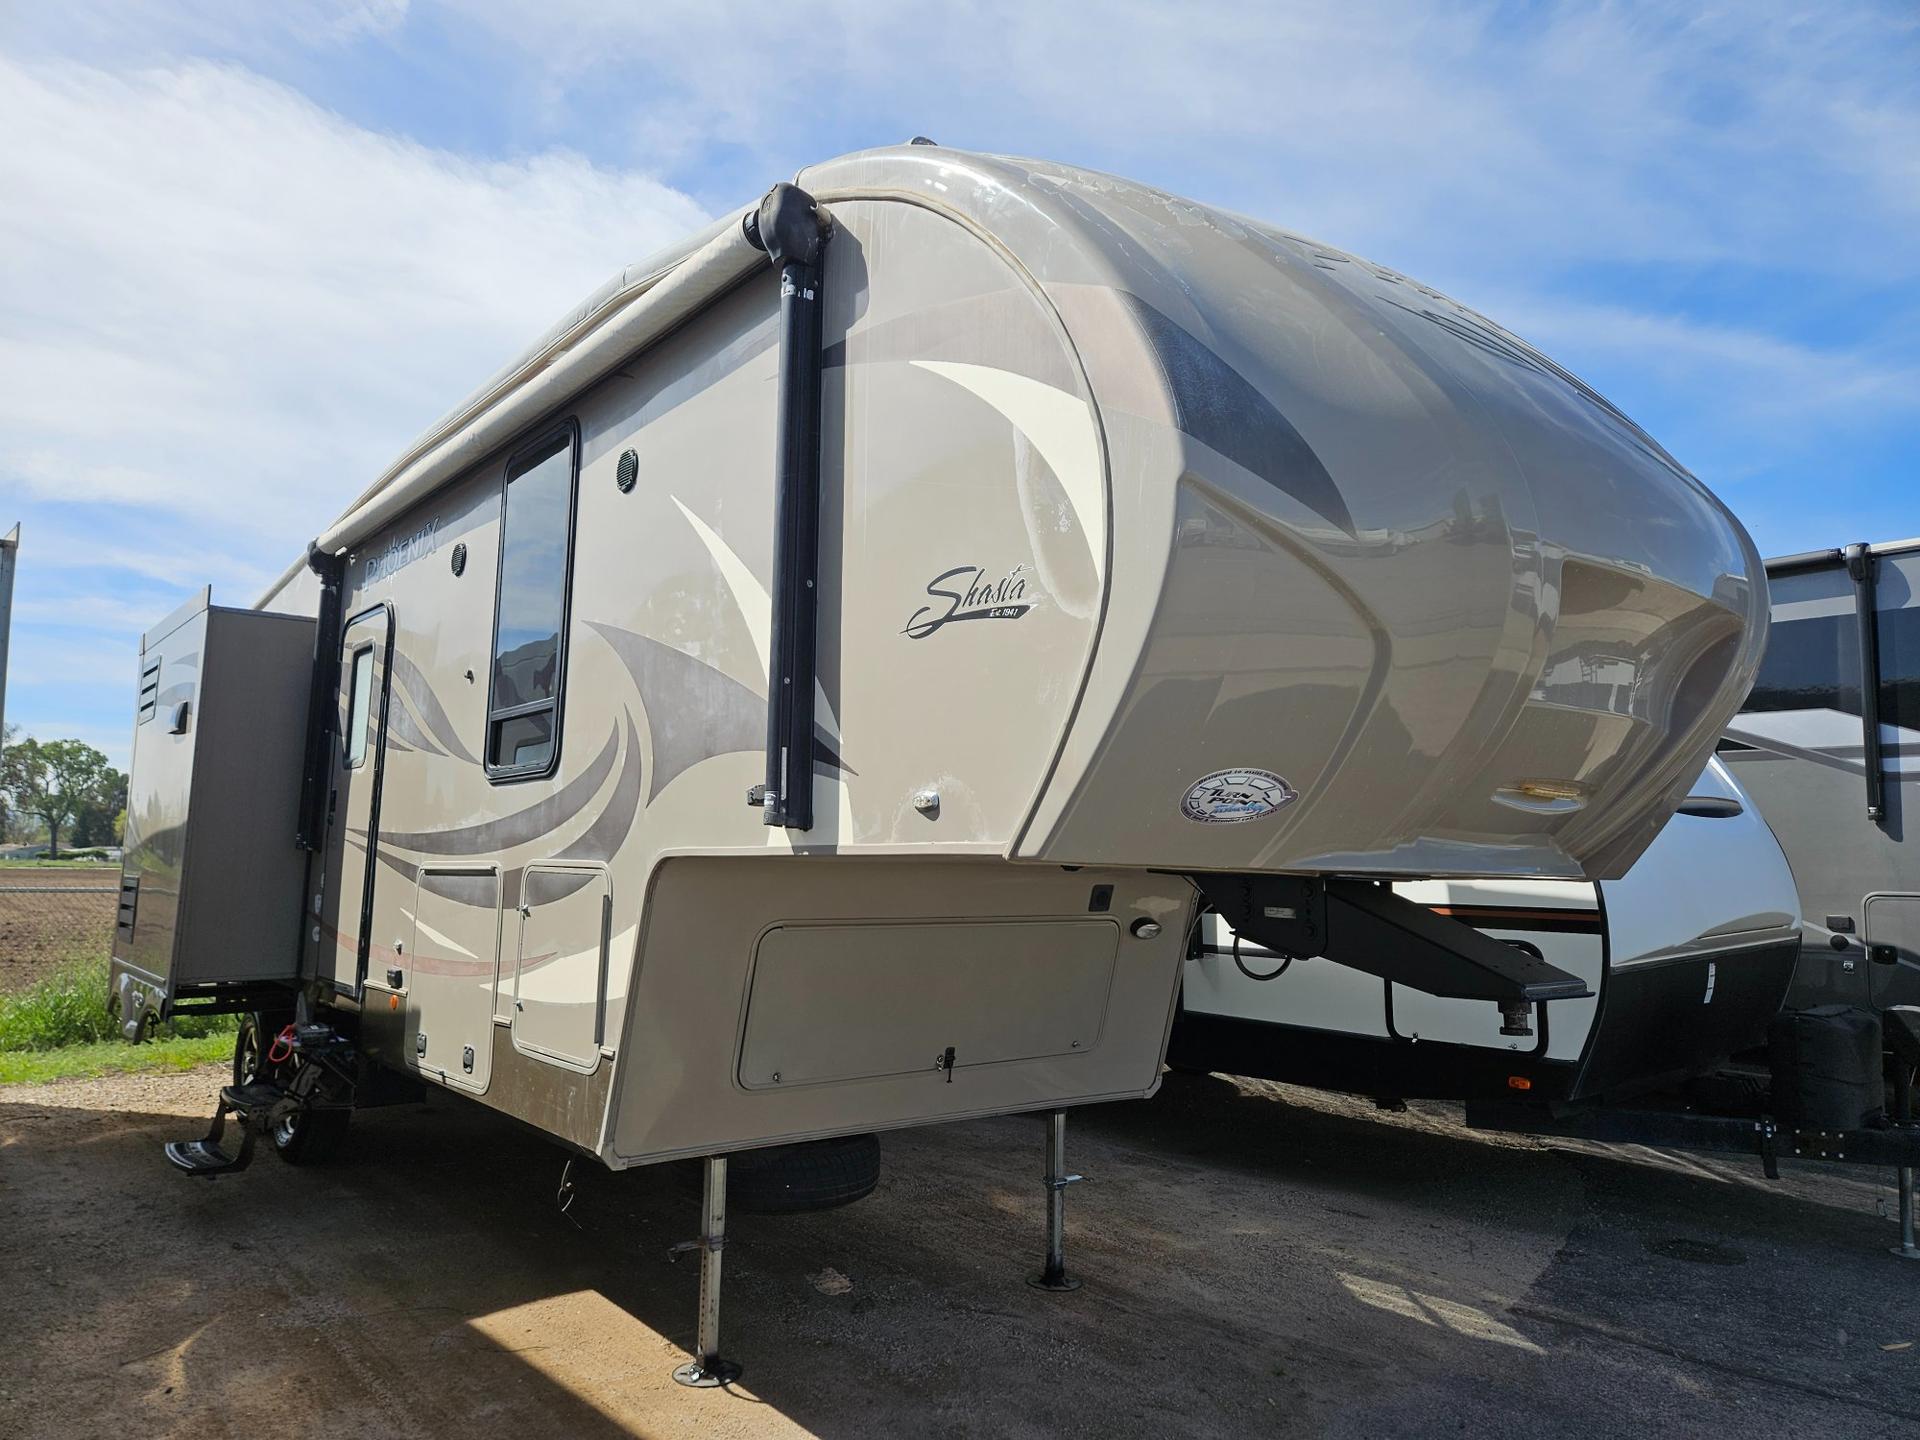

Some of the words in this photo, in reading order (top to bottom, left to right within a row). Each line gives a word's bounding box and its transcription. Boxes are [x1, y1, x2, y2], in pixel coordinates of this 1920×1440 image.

[362, 515, 440, 592] PHOENIX
[899, 564, 1032, 640] Shasta
[1001, 607, 1019, 618] 1941
[1209, 788, 1253, 799] TURN
